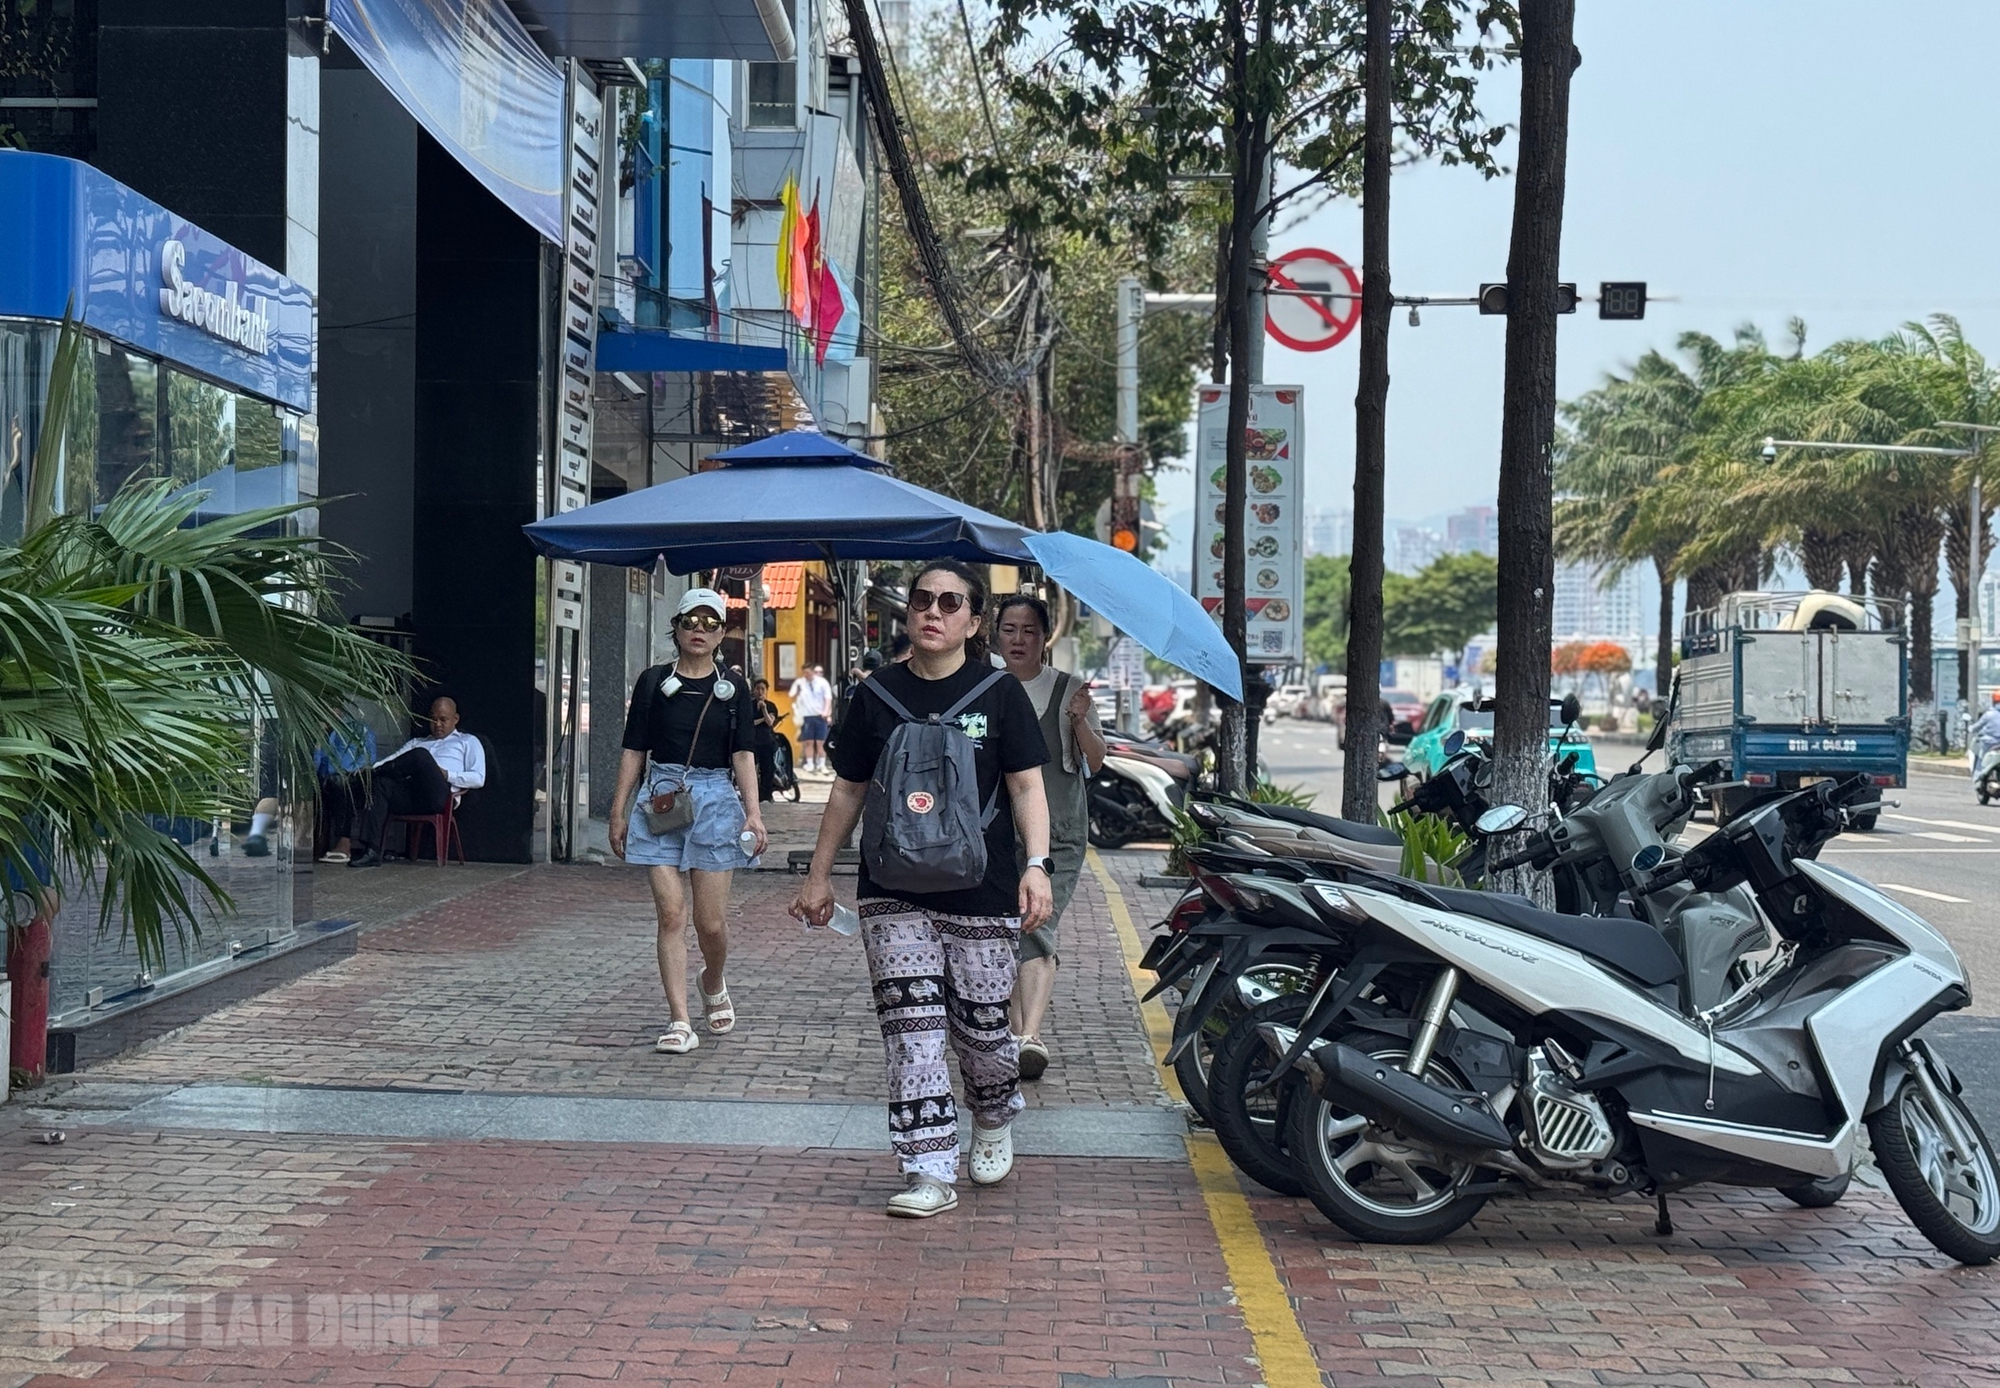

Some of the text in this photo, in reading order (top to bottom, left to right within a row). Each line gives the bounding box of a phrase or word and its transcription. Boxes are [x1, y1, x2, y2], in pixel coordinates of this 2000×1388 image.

[160, 240, 269, 356] Sacombank
[729, 566, 754, 575] PIZZA
[1912, 962, 1944, 983] HONDA
